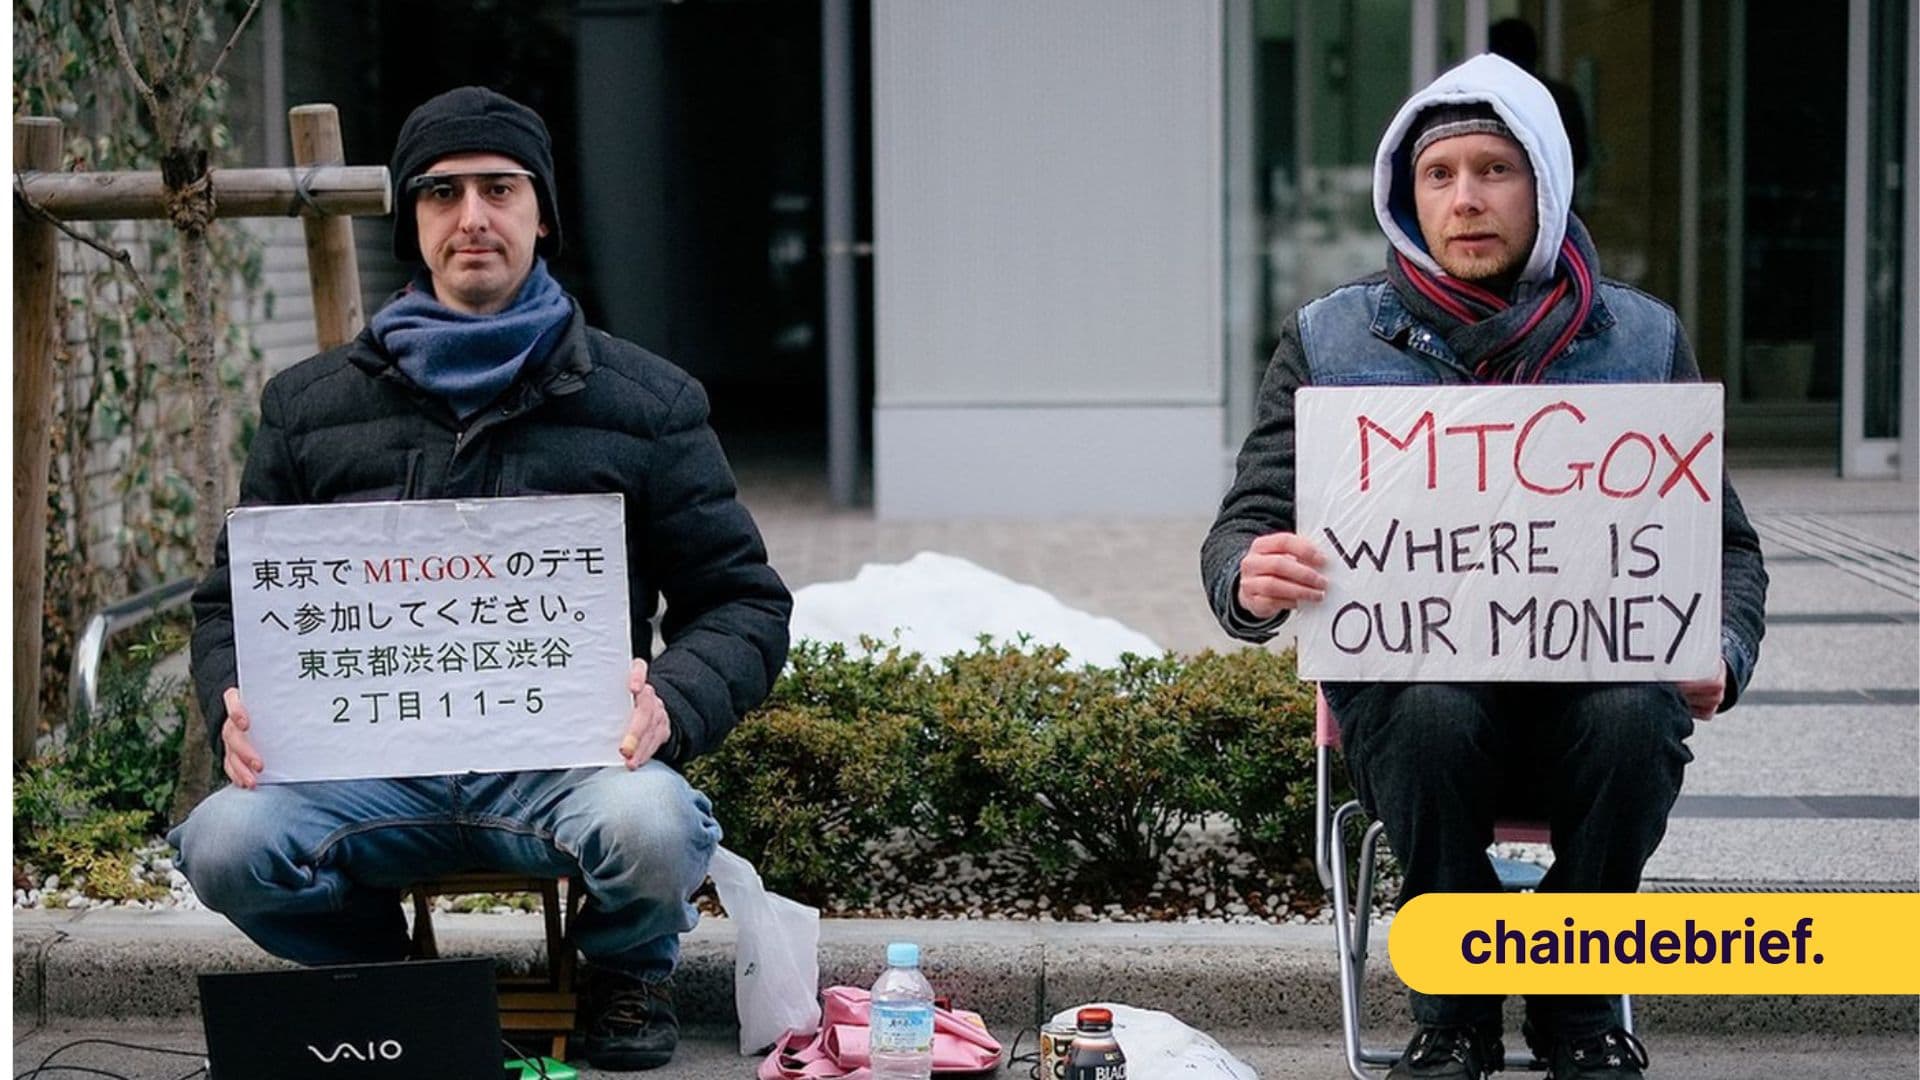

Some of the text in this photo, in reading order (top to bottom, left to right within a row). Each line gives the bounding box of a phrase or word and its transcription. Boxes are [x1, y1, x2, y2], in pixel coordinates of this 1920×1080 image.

[252, 547, 605, 591] 東京で MT.GOX のデモ
[1323, 518, 1664, 578] WHERE IS
[260, 595, 587, 635] へ参加してください。
[1330, 593, 1702, 664] OUR MONEY
[297, 637, 574, 680] 東京都渋谷区渋谷
[308, 1040, 402, 1062] VAIO
